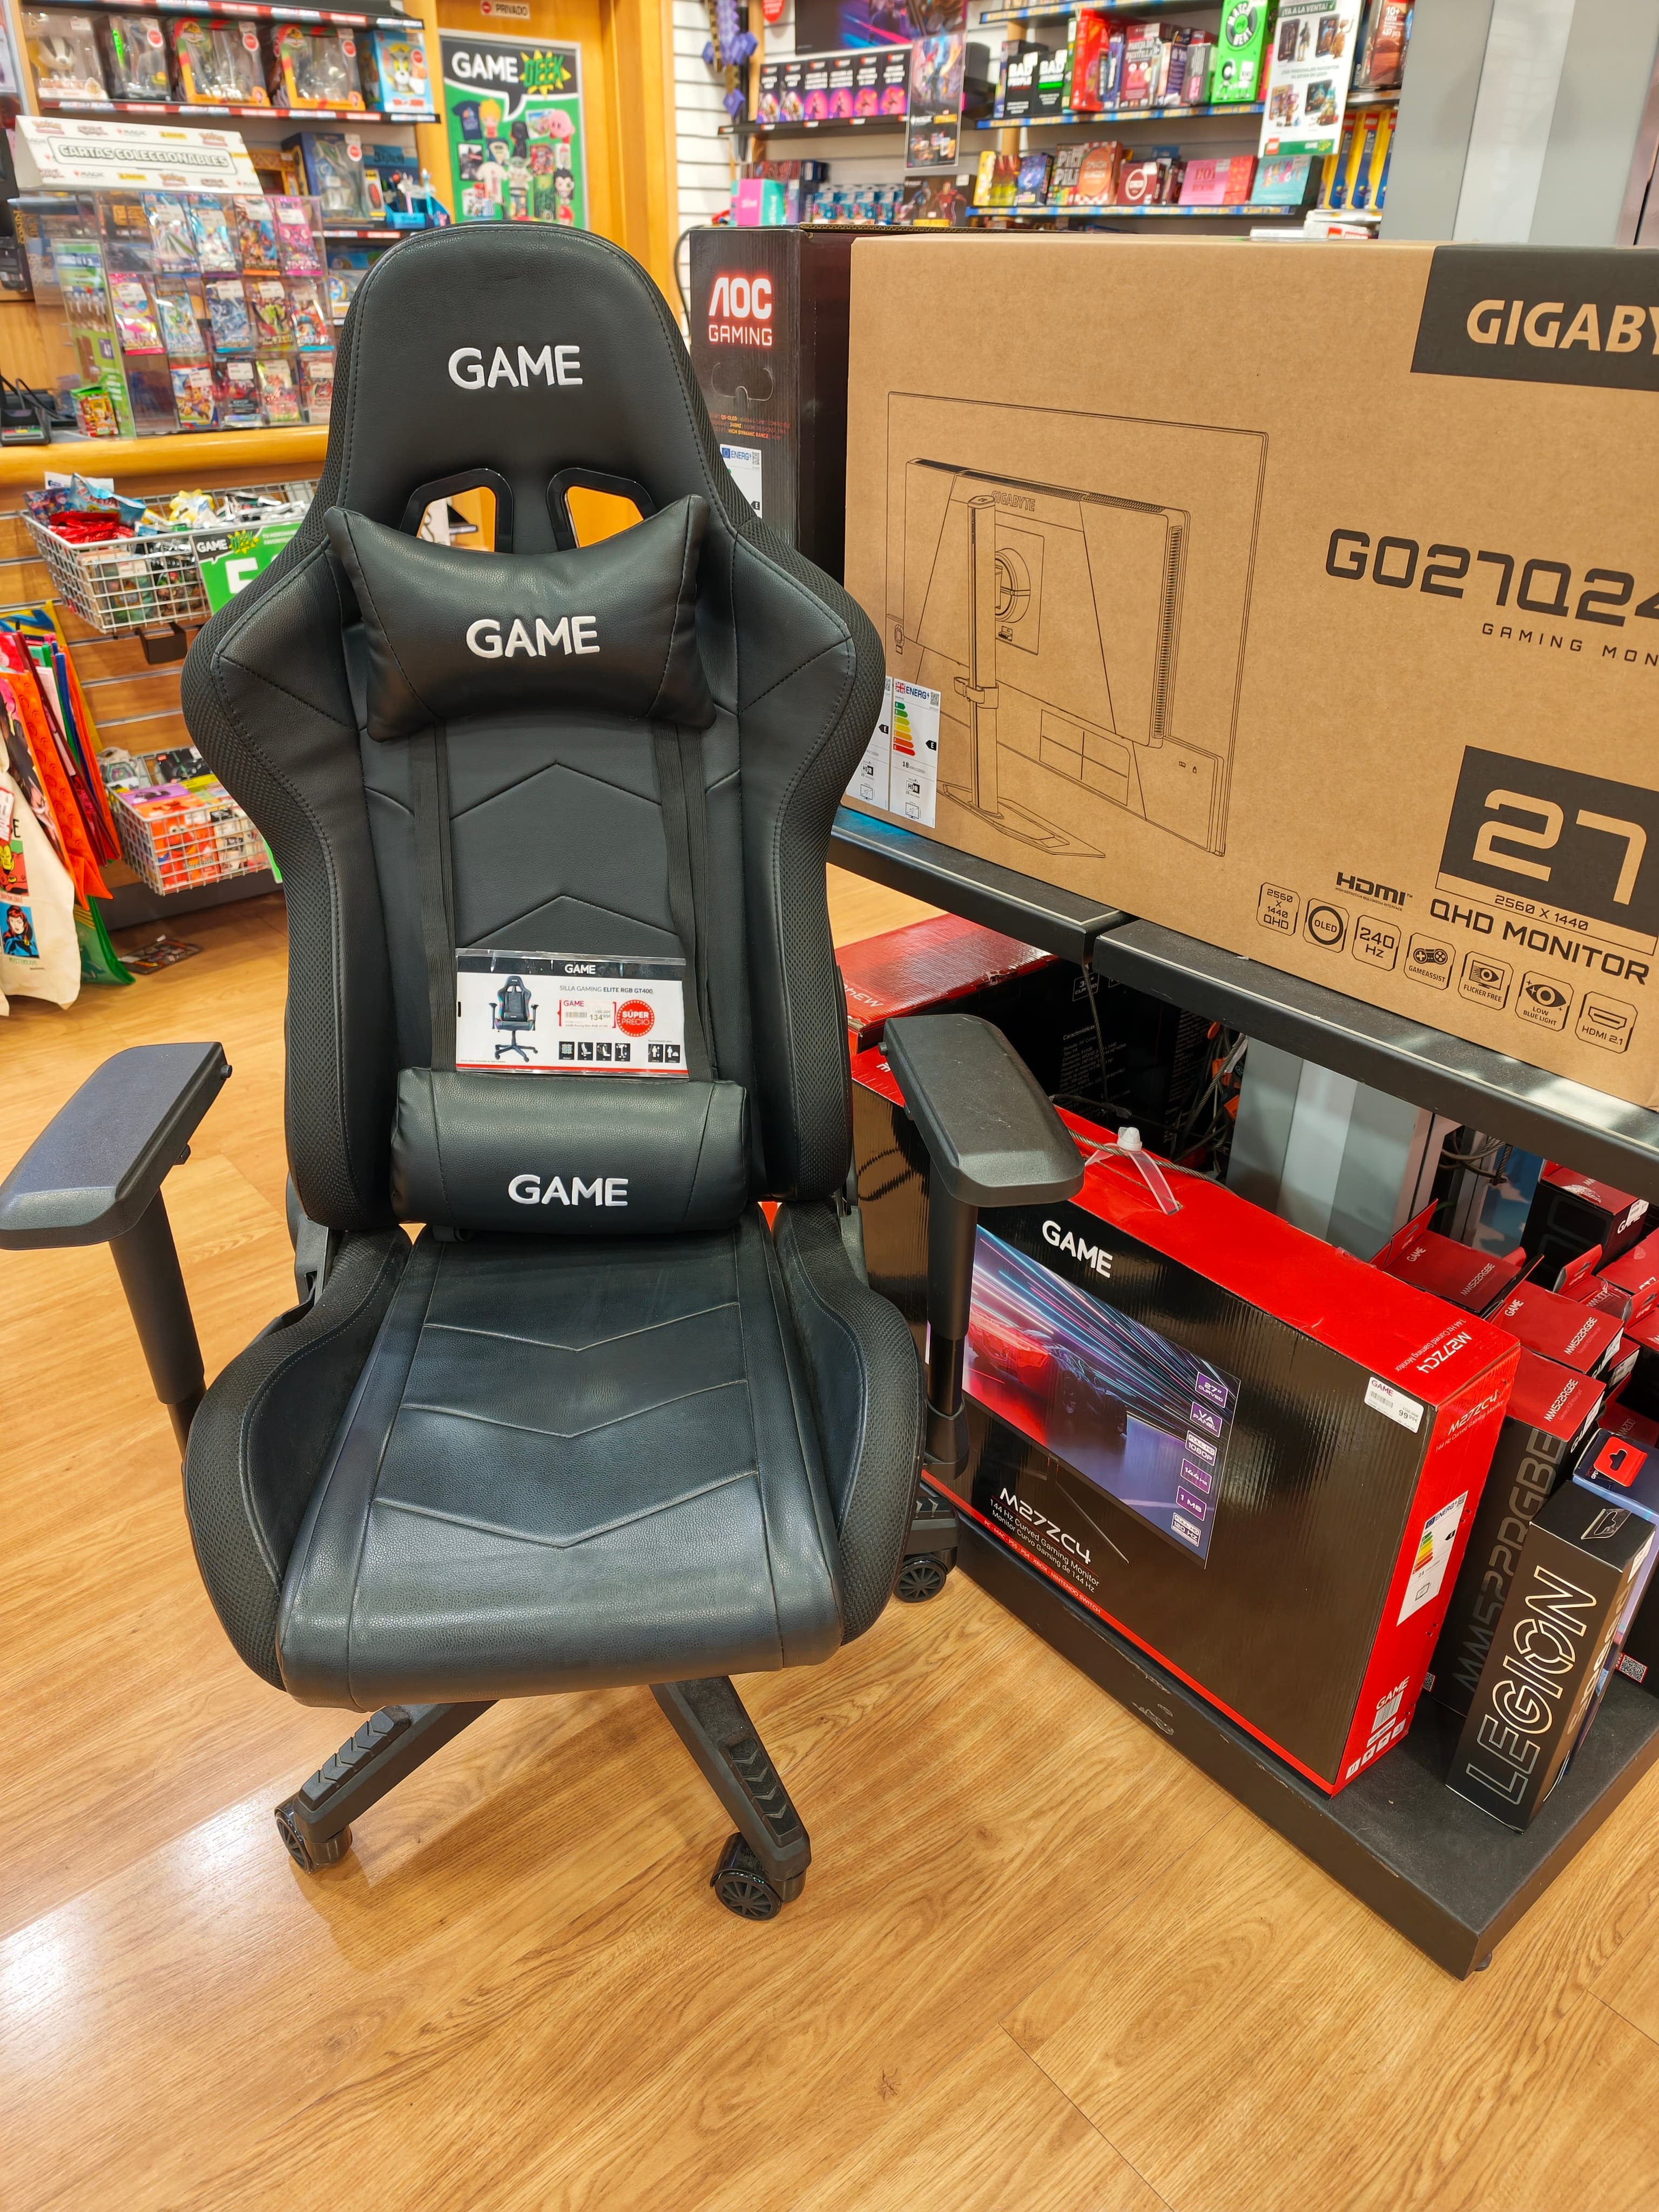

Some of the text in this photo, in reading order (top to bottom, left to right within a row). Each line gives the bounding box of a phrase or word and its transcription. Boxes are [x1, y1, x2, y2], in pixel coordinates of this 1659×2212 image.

[495, 3, 528, 16] PRIVADO
[451, 51, 564, 87] GAME GEEK
[1009, 63, 1033, 77] BAD
[1040, 60, 1065, 75] BAD
[58, 144, 230, 167] CARTAS COLECCIONABLES
[709, 277, 772, 320] AOC
[709, 325, 772, 346] GAMING
[448, 345, 583, 390] GAME
[992, 490, 1036, 511] GIGABYTE
[197, 539, 228, 553] GAME
[466, 616, 601, 659] GAME
[1482, 623, 1583, 651] GAMING
[1472, 788, 1647, 906] 27
[1266, 888, 1293, 903] 2560
[1276, 900, 1283, 908] X
[1363, 896, 1384, 906] MULTIMEDIA
[1383, 902, 1403, 912] INTERFACE
[1263, 913, 1289, 930] QHD
[1267, 906, 1289, 919] 1440
[1494, 894, 1589, 931] 2560 X 1440
[1314, 919, 1338, 933] OLED
[1359, 927, 1395, 949] 240
[1429, 899, 1650, 986] QHD MONITOR
[564, 964, 596, 974] GAME
[1408, 965, 1446, 983] GAMEASSIST
[1463, 984, 1502, 1003] FLICKER FREE
[622, 1009, 649, 1018] SÚPER
[622, 1017, 650, 1026] PRECIO
[1523, 1009, 1557, 1027] BLUE LIGHT
[1532, 1006, 1549, 1016] LOW
[1581, 1025, 1624, 1046] HDMI 2.1
[508, 1174, 629, 1206] GAME
[1042, 1220, 1114, 1279] GAME
[1406, 1246, 1427, 1262] GAME
[1460, 1262, 1495, 1297] MM522RGBE
[1505, 1298, 1525, 1317] GAME
[1395, 1318, 1467, 1372] 144 Hz Curved Gaming Monitor
[1563, 1317, 1598, 1355] MM522RGBE
[1416, 1331, 1473, 1374] M27ZC4
[1198, 1385, 1224, 1402] CURVED
[1371, 1379, 1394, 1397] GAME
[1543, 1378, 1579, 1422] MM522RGBE
[1192, 1413, 1218, 1432] PANEL
[1198, 1409, 1215, 1426] VA
[1448, 1389, 1499, 1436] M27ZC4
[1452, 1425, 1468, 1441] Curved
[1468, 1414, 1486, 1430] Gaming
[1486, 1400, 1504, 1418] Monitor
[1188, 1442, 1213, 1461] 1080P
[1184, 1466, 1199, 1480] 144
[1186, 1499, 1203, 1513] MS
[1000, 1487, 1091, 1565] M27ZC4
[1174, 1521, 1186, 1532] 120
[990, 1499, 1100, 1588] 144 Hz Curved Gaming Monitor
[992, 1509, 1095, 1594] Monitor Curvo Gaming de 144 Hz
[984, 1520, 1101, 1614] PC MAC PS5 PS4 XBOX NINTENDO SWITCH
[1376, 1676, 1410, 1710] GAME
[1466, 1566, 1597, 1805] LEGION
